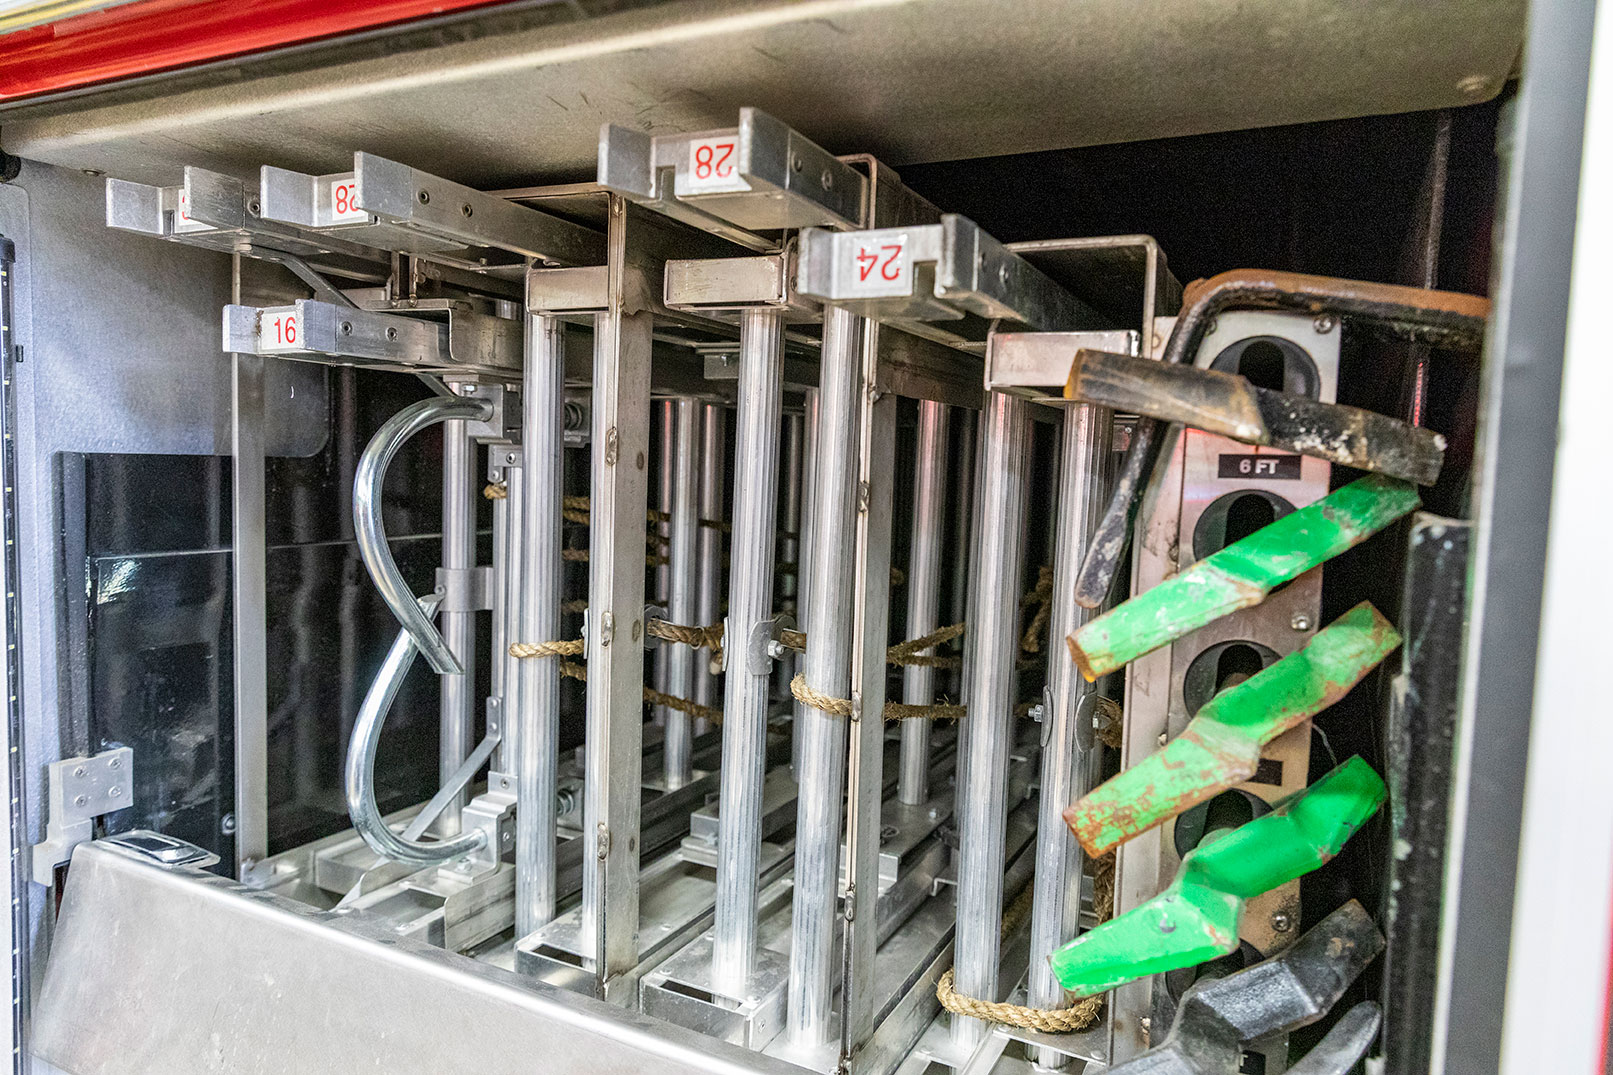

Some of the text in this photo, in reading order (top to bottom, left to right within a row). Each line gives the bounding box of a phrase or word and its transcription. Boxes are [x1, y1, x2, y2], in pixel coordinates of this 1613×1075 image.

[696, 143, 735, 180] 28
[856, 245, 903, 282] 24
[273, 317, 297, 344] 16
[1240, 459, 1280, 475] 6 FT
